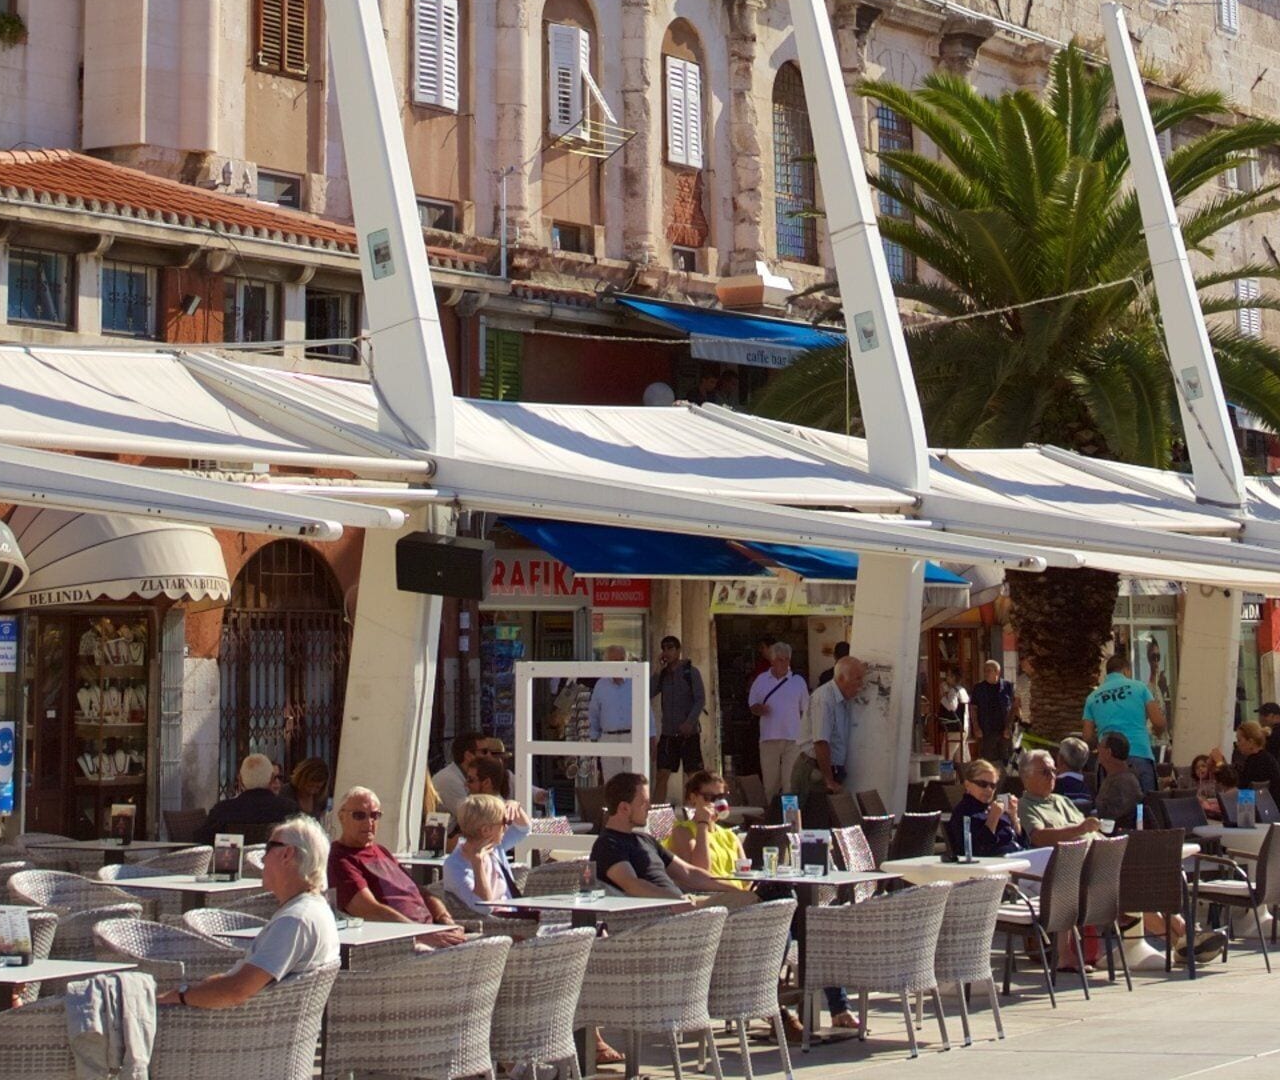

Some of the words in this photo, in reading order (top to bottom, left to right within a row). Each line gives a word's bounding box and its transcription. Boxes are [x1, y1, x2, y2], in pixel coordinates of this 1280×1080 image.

[746, 350, 769, 364] caffe
[140, 578, 198, 592] ZLATARNA
[29, 589, 93, 606] BELINDA
[595, 591, 611, 601] ECO
[612, 591, 644, 601] PRODUCTS
